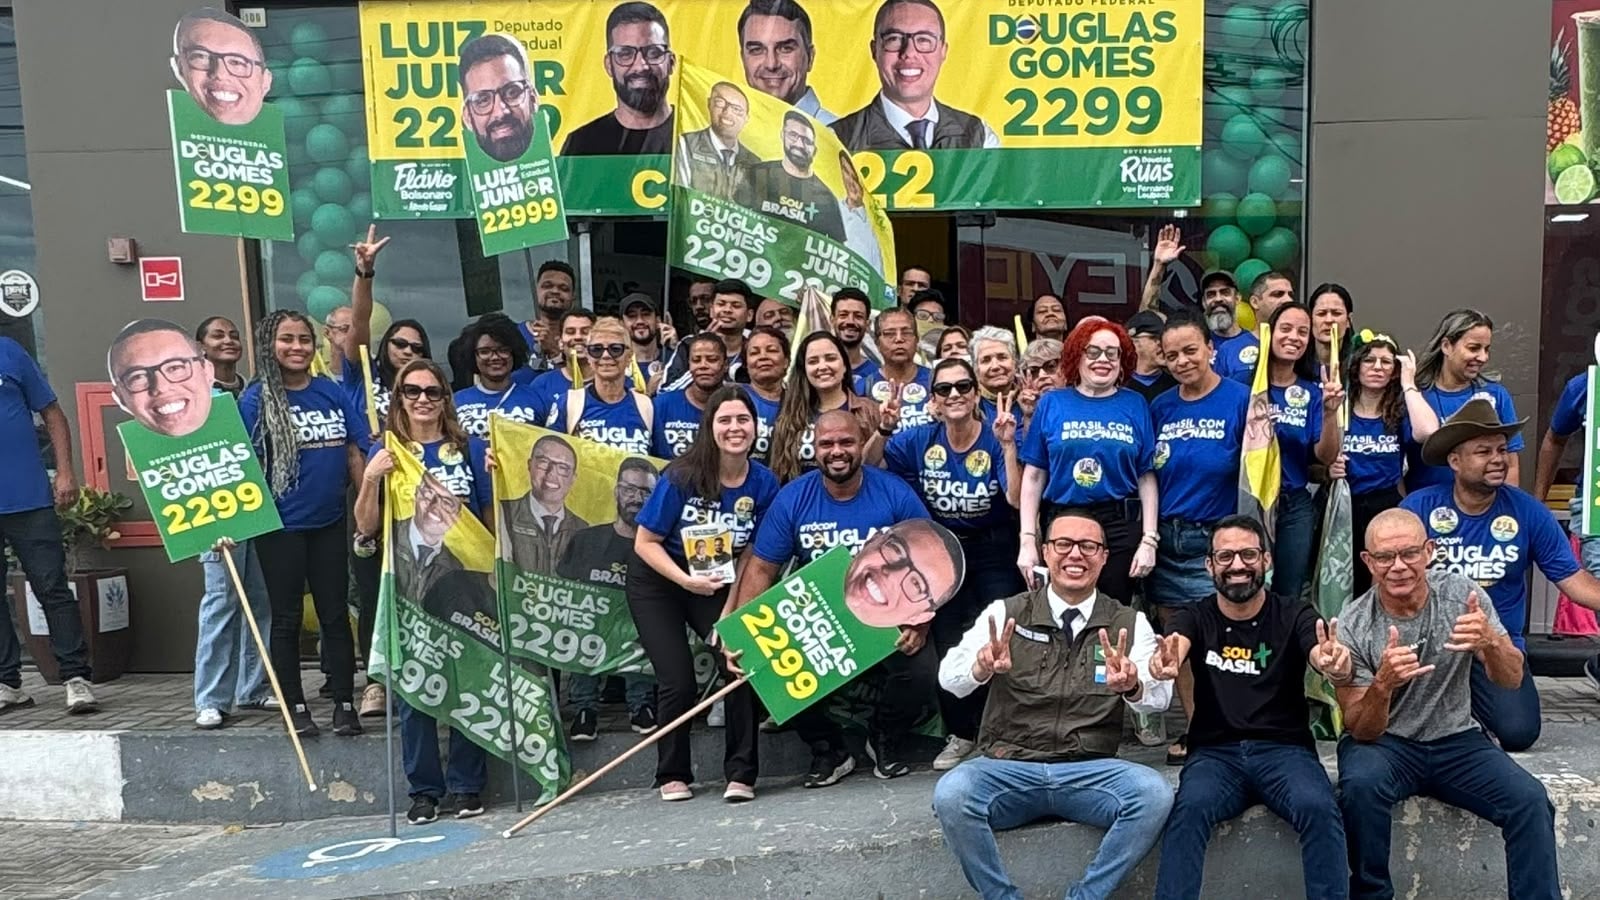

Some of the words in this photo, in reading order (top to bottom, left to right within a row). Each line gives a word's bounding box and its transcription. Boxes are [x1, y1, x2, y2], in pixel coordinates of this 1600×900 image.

[494, 19, 563, 34] Deputado
[989, 11, 1177, 45] DOUGLAS
[1009, 46, 1156, 79] GOMES
[1003, 86, 1163, 136] 2299
[180, 140, 284, 169] DOUGLAS
[1120, 155, 1174, 183] Ruas
[194, 160, 274, 185] GOMES
[394, 162, 457, 192] Flávio
[473, 165, 520, 192] LUIZ
[851, 151, 934, 208] 22
[188, 180, 285, 216] 2299
[400, 190, 453, 200] Bolsonaro
[479, 176, 555, 209] JUNIOR
[780, 196, 803, 210] SOU
[482, 197, 558, 234] 22999
[690, 198, 779, 243] DOUGLAS
[761, 201, 808, 224] BRASIL
[695, 218, 765, 255] GOMES
[804, 236, 850, 268] LUIZ
[683, 234, 772, 288] 2299
[1063, 421, 1105, 431] BRASIL
[1108, 422, 1133, 434] COM
[1162, 418, 1195, 432] BRASIL
[1199, 418, 1225, 429] COM
[1284, 407, 1307, 417] COM
[1062, 429, 1134, 444] BOLSONARO
[141, 443, 250, 488] DOUGLAS
[161, 463, 245, 500] GOMES
[161, 482, 263, 536] 2299
[512, 575, 611, 615] DOUGLAS
[450, 611, 501, 648] BRASIL
[474, 611, 501, 632] SOU
[521, 598, 596, 630] GOMES
[784, 576, 857, 677] DOUGLAS
[399, 628, 446, 670] OMES
[509, 613, 607, 668] 2299
[740, 604, 818, 700] 2299
[776, 599, 834, 677] GOMES
[1222, 646, 1251, 660] SOU
[1205, 650, 1260, 675] BRASIL
